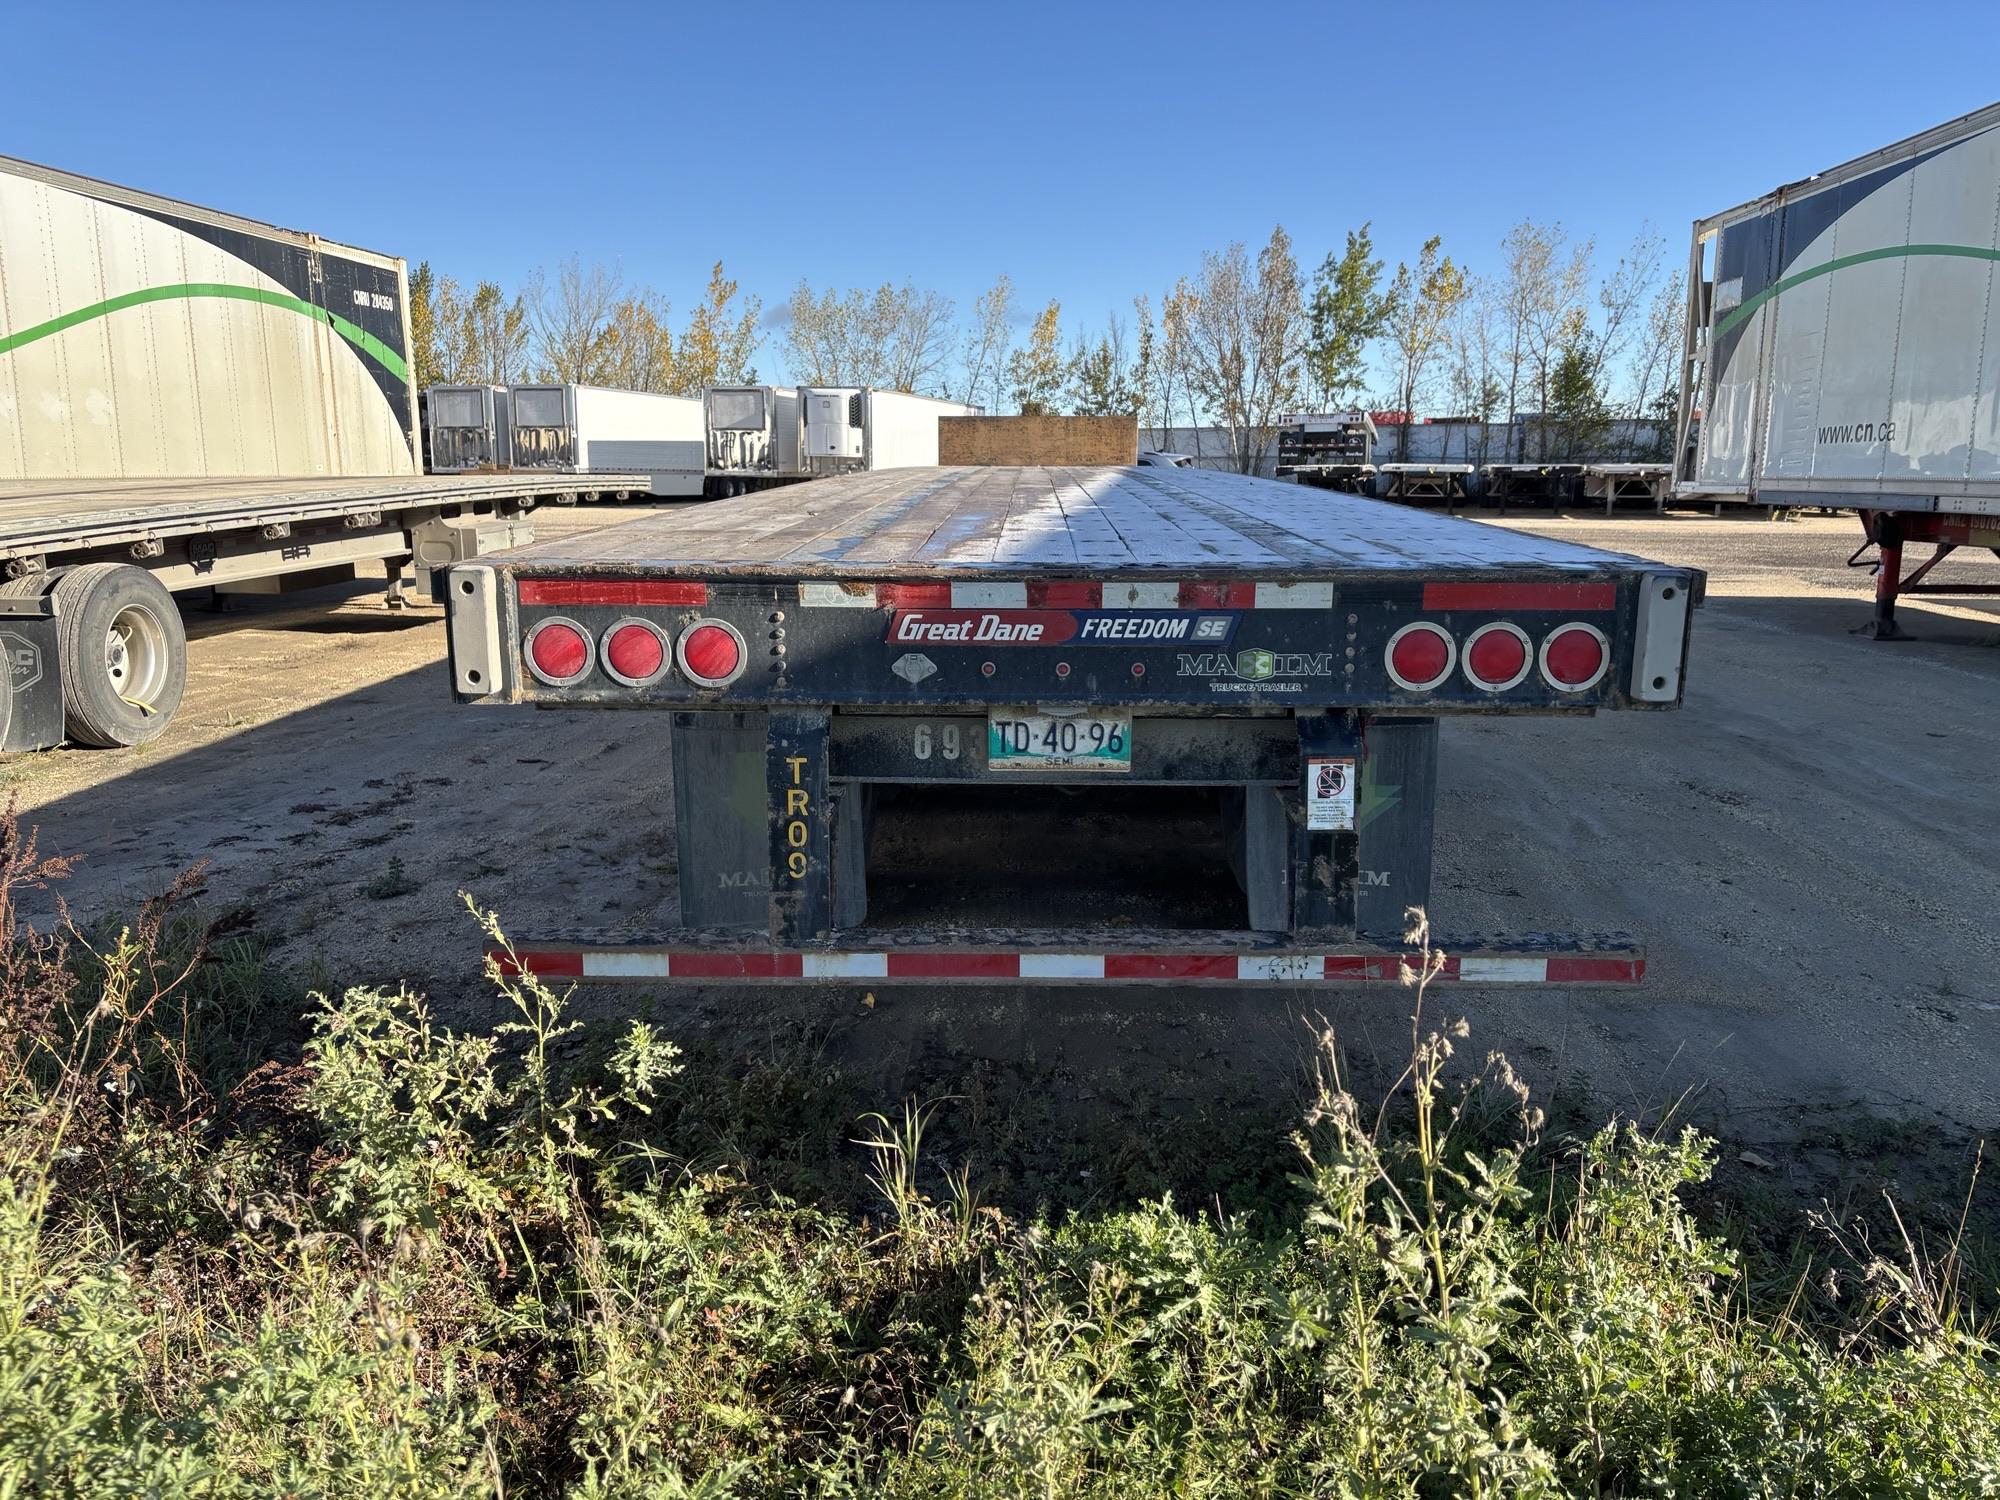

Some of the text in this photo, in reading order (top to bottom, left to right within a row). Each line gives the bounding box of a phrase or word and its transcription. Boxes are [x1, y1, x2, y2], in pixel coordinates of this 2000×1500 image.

[1818, 422, 1896, 444] www.cn.ca
[897, 614, 1227, 641] Great Dane FREEDOM SE
[1045, 756, 1074, 766] SEMI
